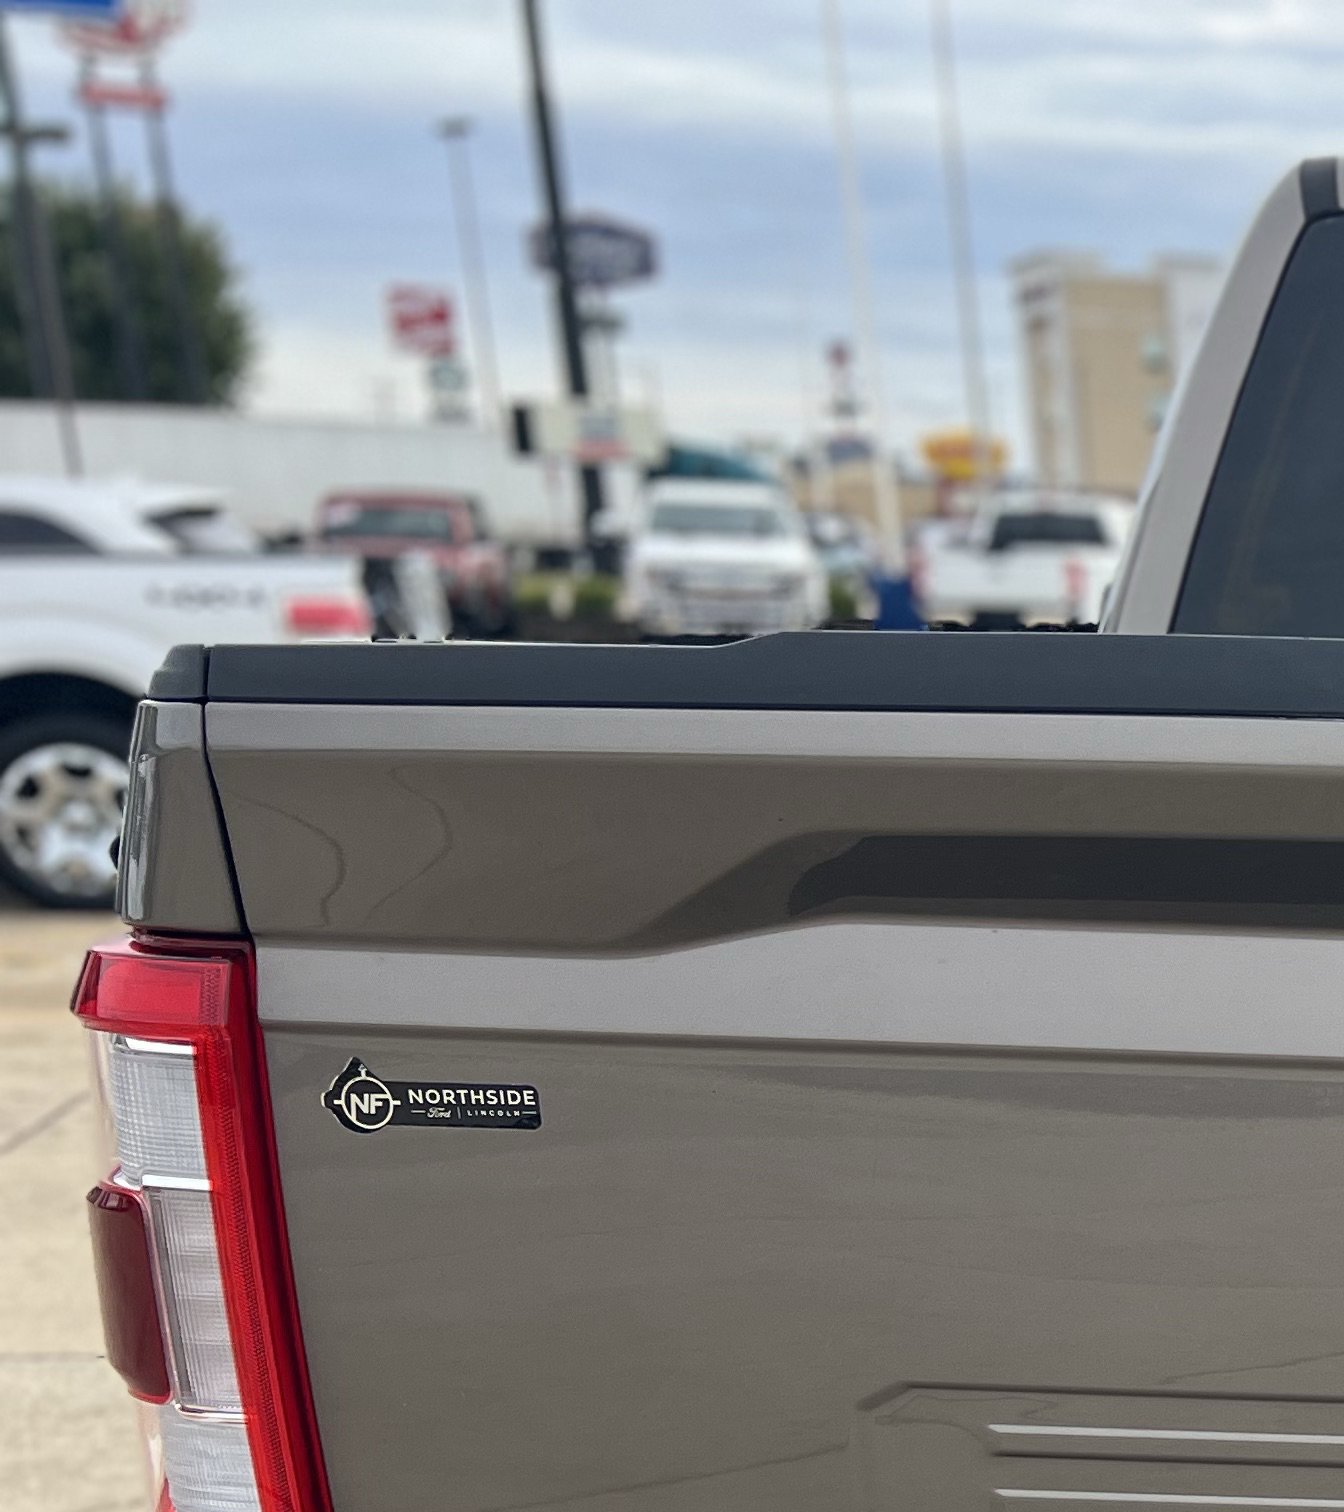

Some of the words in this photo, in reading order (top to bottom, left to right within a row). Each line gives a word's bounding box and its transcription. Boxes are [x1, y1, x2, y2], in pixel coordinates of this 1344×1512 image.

[408, 1088, 536, 1106] NORTHSIDE
[427, 1107, 452, 1118] Ford
[466, 1109, 521, 1117] LINCOLN
